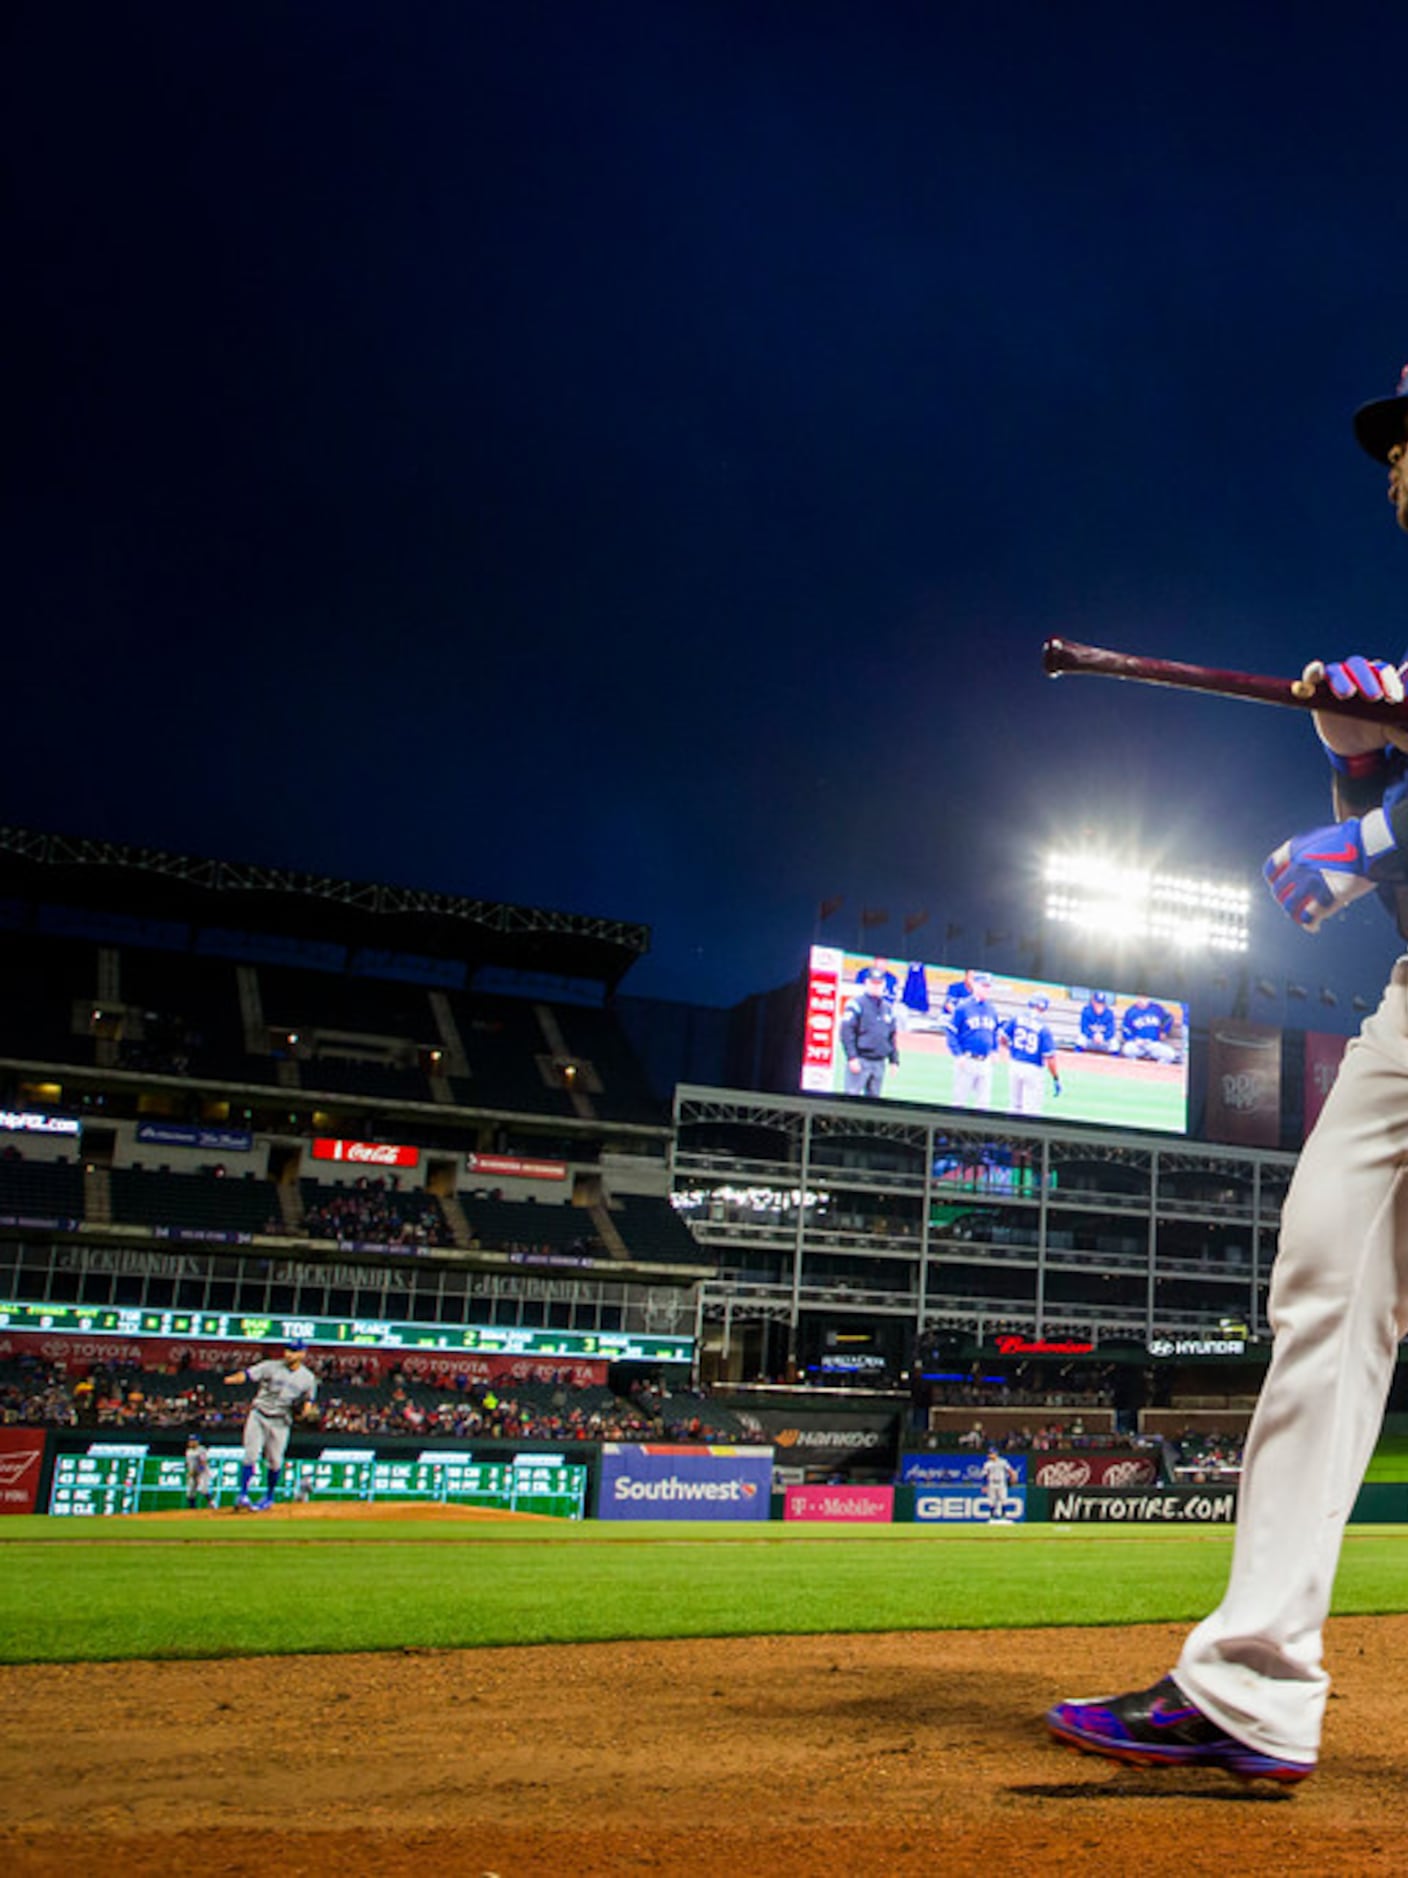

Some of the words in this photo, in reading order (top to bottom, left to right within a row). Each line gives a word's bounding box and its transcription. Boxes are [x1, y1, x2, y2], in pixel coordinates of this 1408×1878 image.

[1014, 1027, 1039, 1053] 29
[282, 1322, 316, 1338] TOR
[464, 1331, 477, 1347] 2
[584, 1337, 597, 1353] 3
[996, 1336, 1094, 1354] Budweiser
[70, 1343, 142, 1358] TOYOTA
[1175, 1340, 1244, 1355] HYUNDAI
[198, 1350, 263, 1364] TOYOTA
[427, 1359, 489, 1373] TOYOTA
[614, 1476, 742, 1501] Southwest
[916, 1496, 1025, 1520] GEICO
[1053, 1493, 1236, 1521] NITTOTIRE.COM
